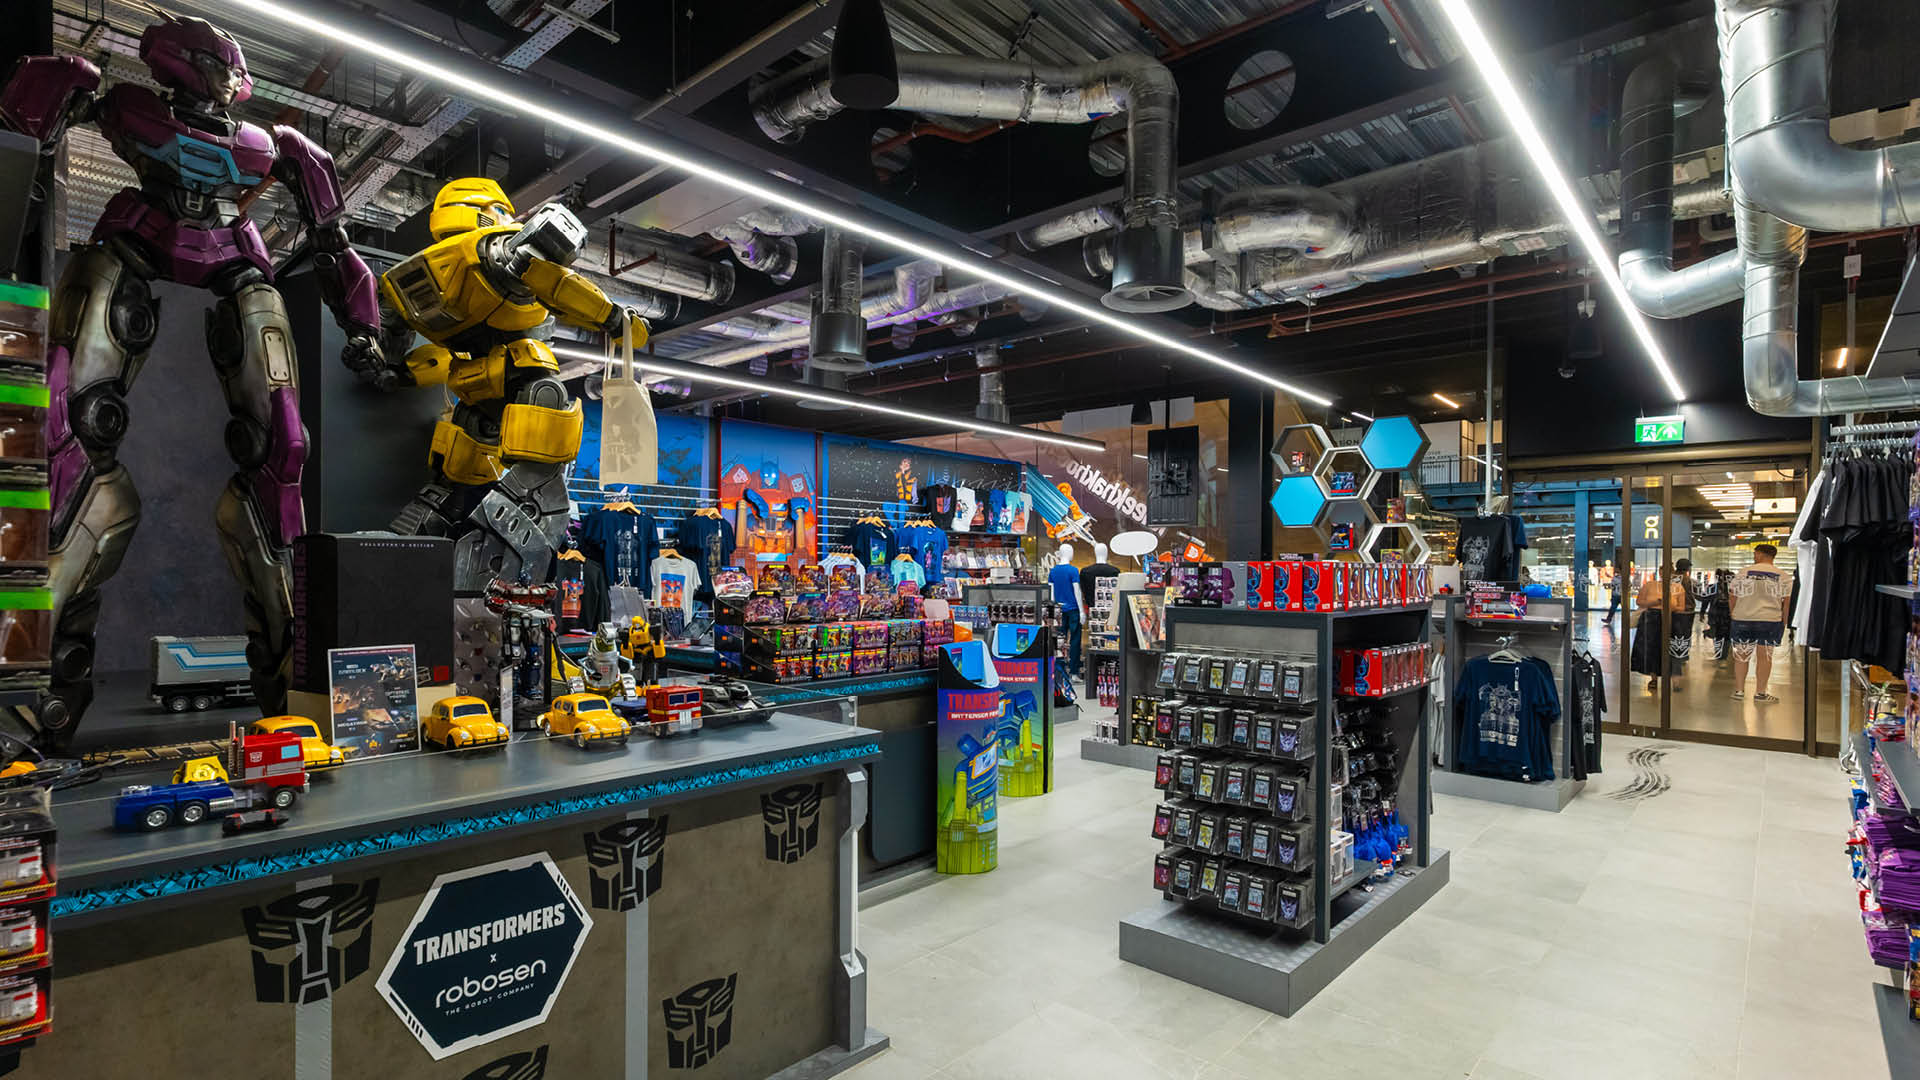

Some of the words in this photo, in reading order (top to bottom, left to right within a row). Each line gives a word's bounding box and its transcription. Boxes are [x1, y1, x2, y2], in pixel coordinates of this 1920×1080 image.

[413, 902, 566, 966] TRANSFORMERS
[435, 959, 547, 1009] robosen
[445, 1007, 460, 1016] THE
[465, 996, 493, 1009] ROBOT
[497, 983, 535, 999] COMPANY
